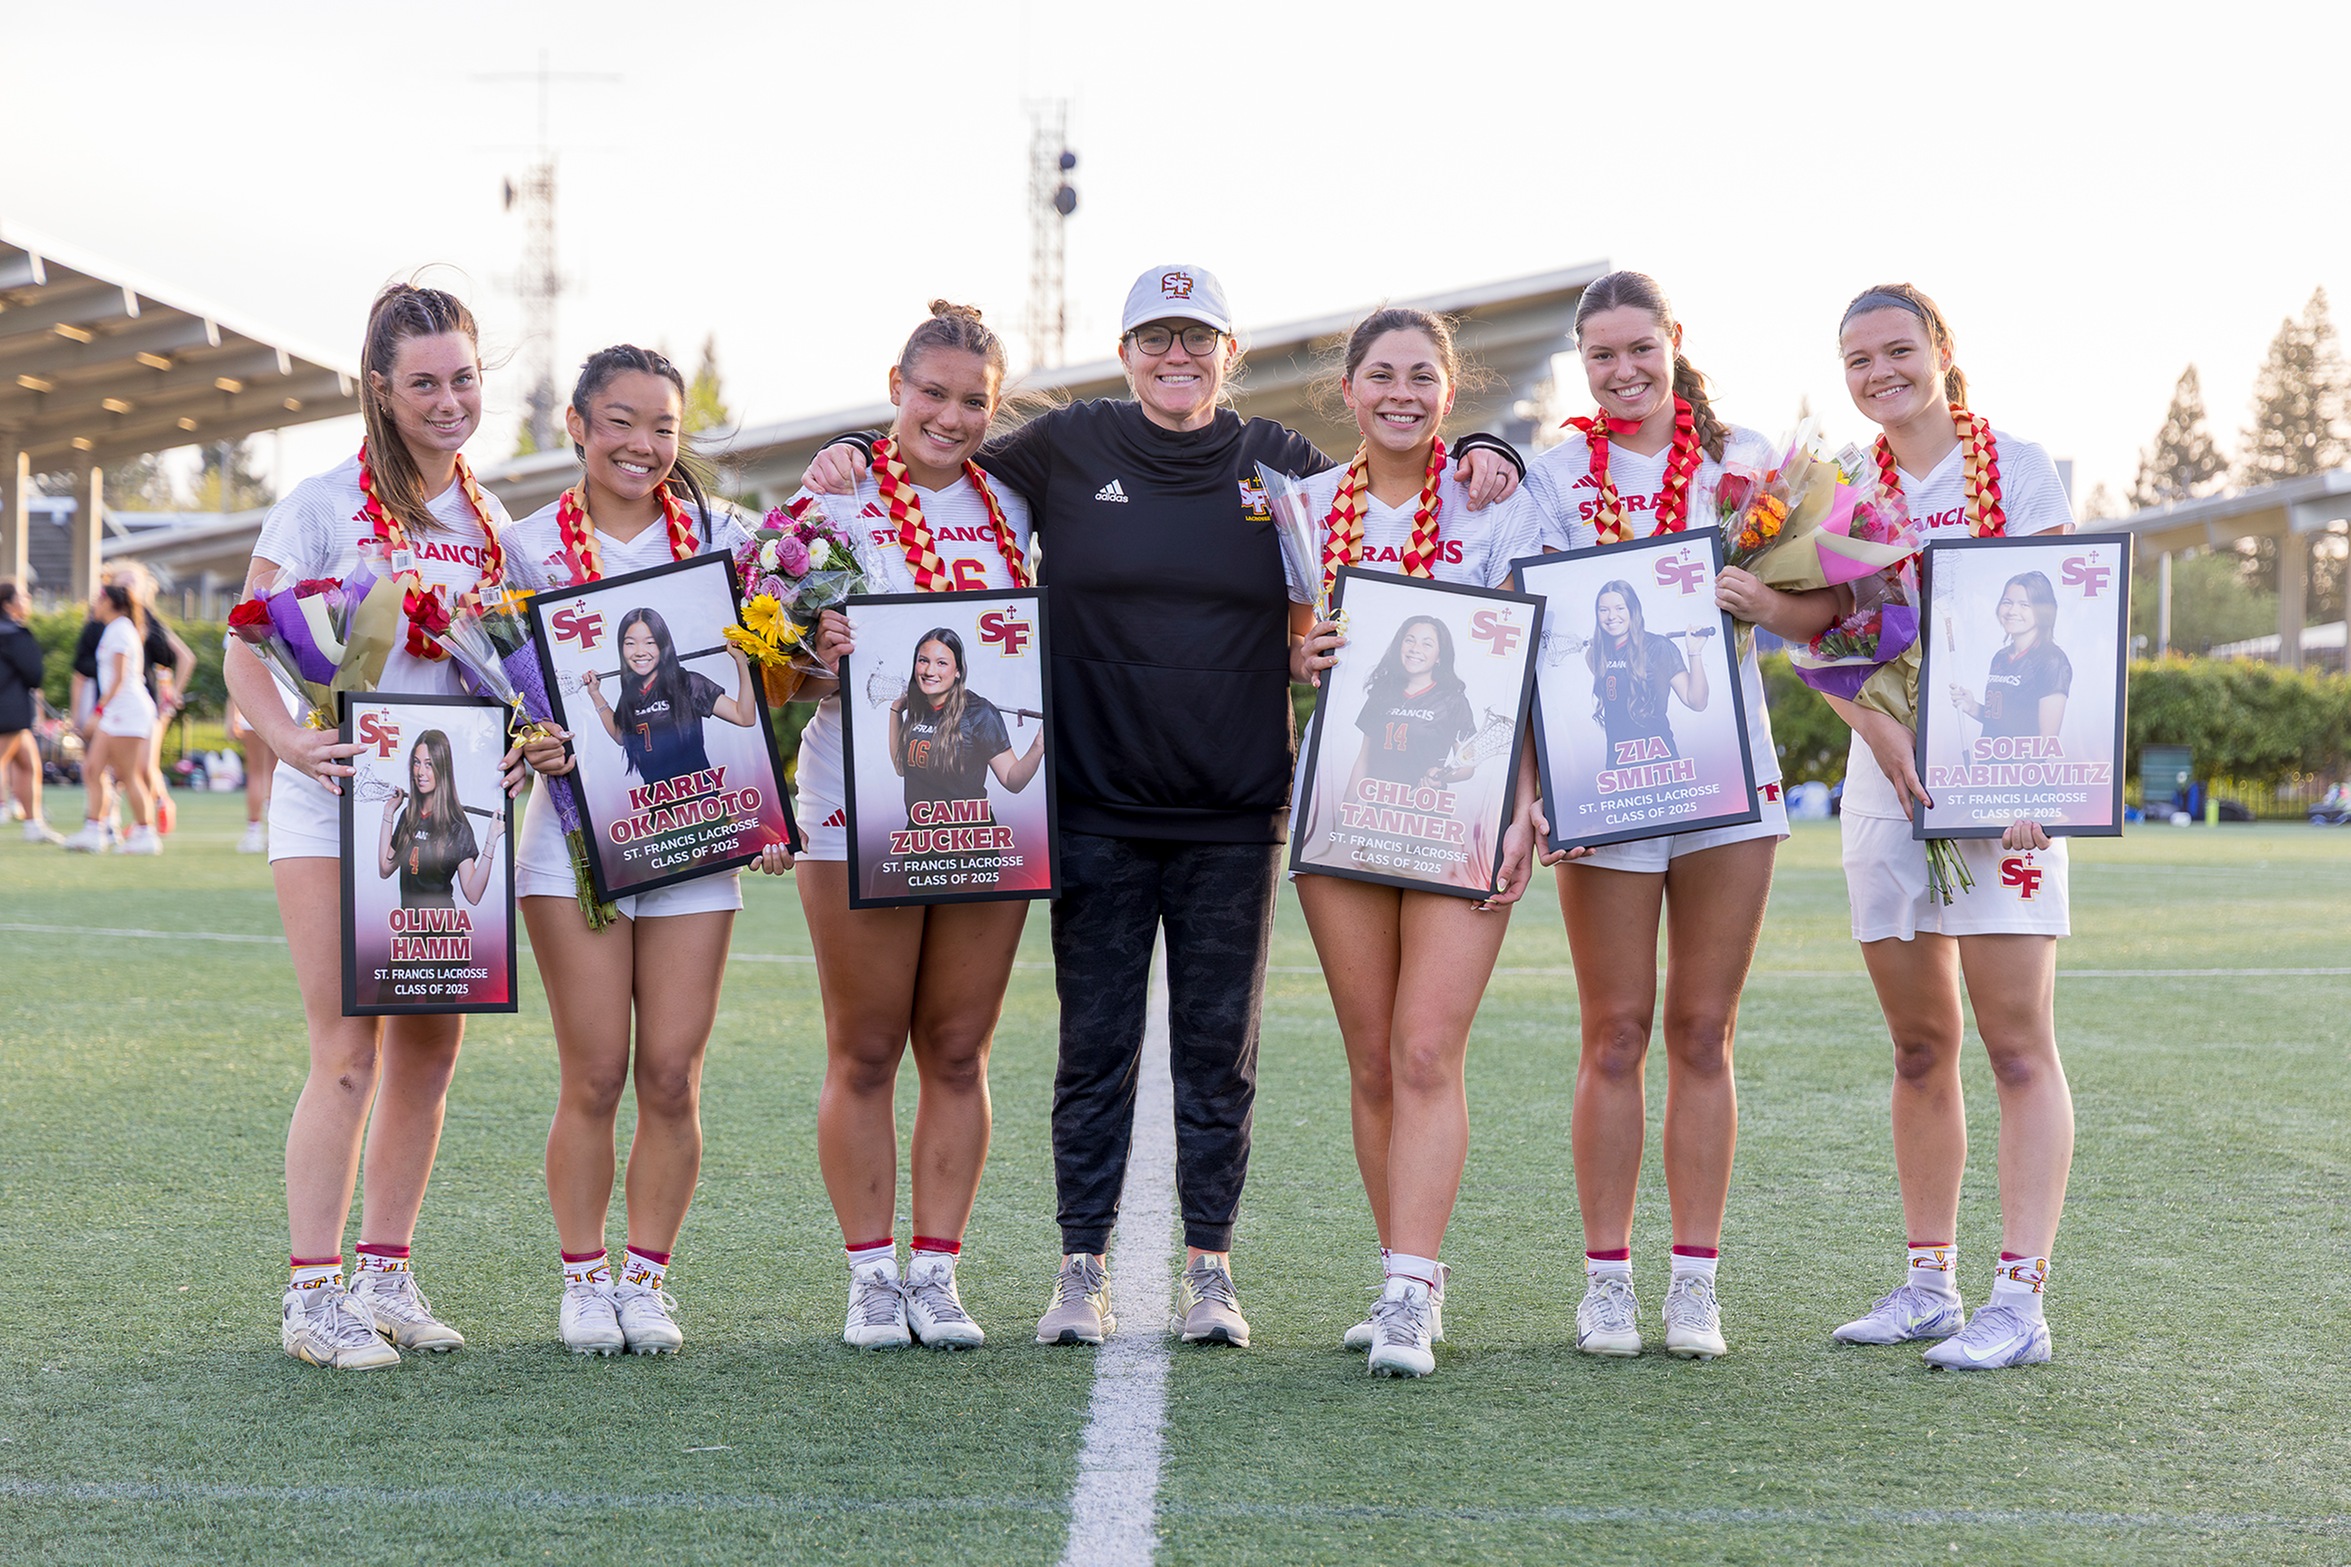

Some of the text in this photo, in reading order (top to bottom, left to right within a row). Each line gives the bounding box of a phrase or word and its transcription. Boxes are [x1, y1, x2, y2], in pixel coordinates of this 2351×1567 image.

[1094, 492, 1129, 503] adidas
[1654, 556, 1707, 597] SF
[2061, 556, 2111, 598] SF
[551, 606, 606, 651] SF
[978, 611, 1034, 657] SF
[1470, 609, 1522, 657] SF
[358, 710, 401, 760] SF
[636, 722, 652, 752] 7
[1384, 721, 1408, 752] 14
[1973, 736, 2065, 760] SOFIA
[908, 739, 931, 768] 16
[1615, 736, 1671, 765] ZIA
[627, 765, 728, 812] KARLY
[1596, 758, 1696, 795] SMITH
[1926, 761, 2111, 788] RABINOVITZ
[1357, 778, 1457, 815] CHLOE
[1579, 784, 1720, 814] ST. FRANCIS LACROSSE
[1947, 792, 2087, 805] ST. FRANCIS LACROSSE
[609, 786, 762, 845] OKAMOTO
[911, 799, 991, 825] CAMI
[1340, 802, 1465, 844] TANNER
[1605, 802, 1697, 825] CLASS OF 2025
[1971, 807, 2062, 819] CLASS OF 2025
[623, 817, 760, 861] ST. FRANCIS LACROSSE
[651, 838, 740, 869] CLASS OF 2025
[890, 826, 1015, 855] ZUCKER
[1329, 831, 1469, 863] ST. FRANCIS LACROSSE
[882, 856, 1023, 873] ST. FRANCIS LACROSSE
[1351, 850, 1442, 874] CLASS OF 2025
[908, 872, 999, 886] CLASS OF 2025
[2000, 856, 2043, 900] SF
[388, 908, 474, 933] OLIVIA
[390, 937, 472, 961] HAMM
[374, 968, 488, 980] ST. FRANCIS LACROSSE
[394, 984, 469, 995] CLASS OF 2025
